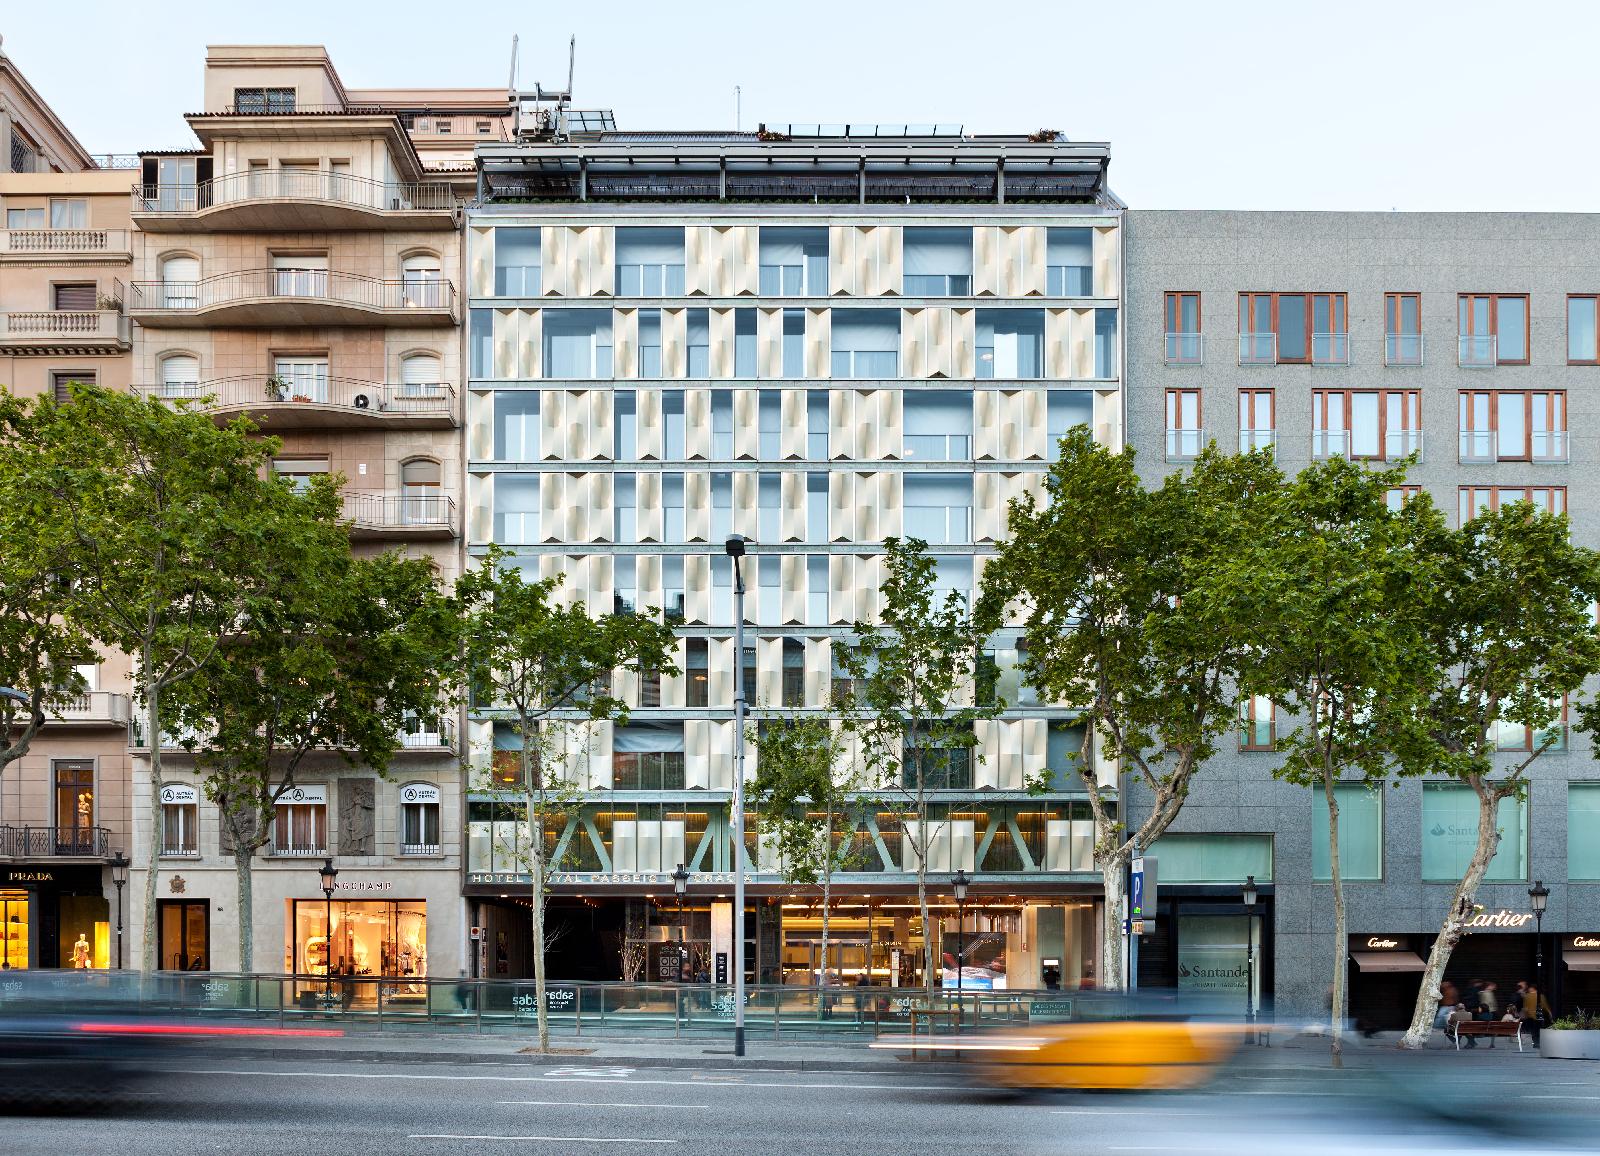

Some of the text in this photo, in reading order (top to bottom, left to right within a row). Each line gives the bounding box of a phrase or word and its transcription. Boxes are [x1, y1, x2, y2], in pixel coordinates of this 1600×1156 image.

[8, 872, 54, 881] PRADA
[472, 874, 524, 883] HOTEL
[532, 874, 583, 883] OYAL
[591, 874, 657, 883] PASSEIG
[319, 881, 393, 891] LNGCHAMP
[1134, 876, 1140, 904] P
[1463, 904, 1533, 927] Cartier
[1367, 937, 1398, 948] Cartier
[1192, 964, 1249, 978] Santande
